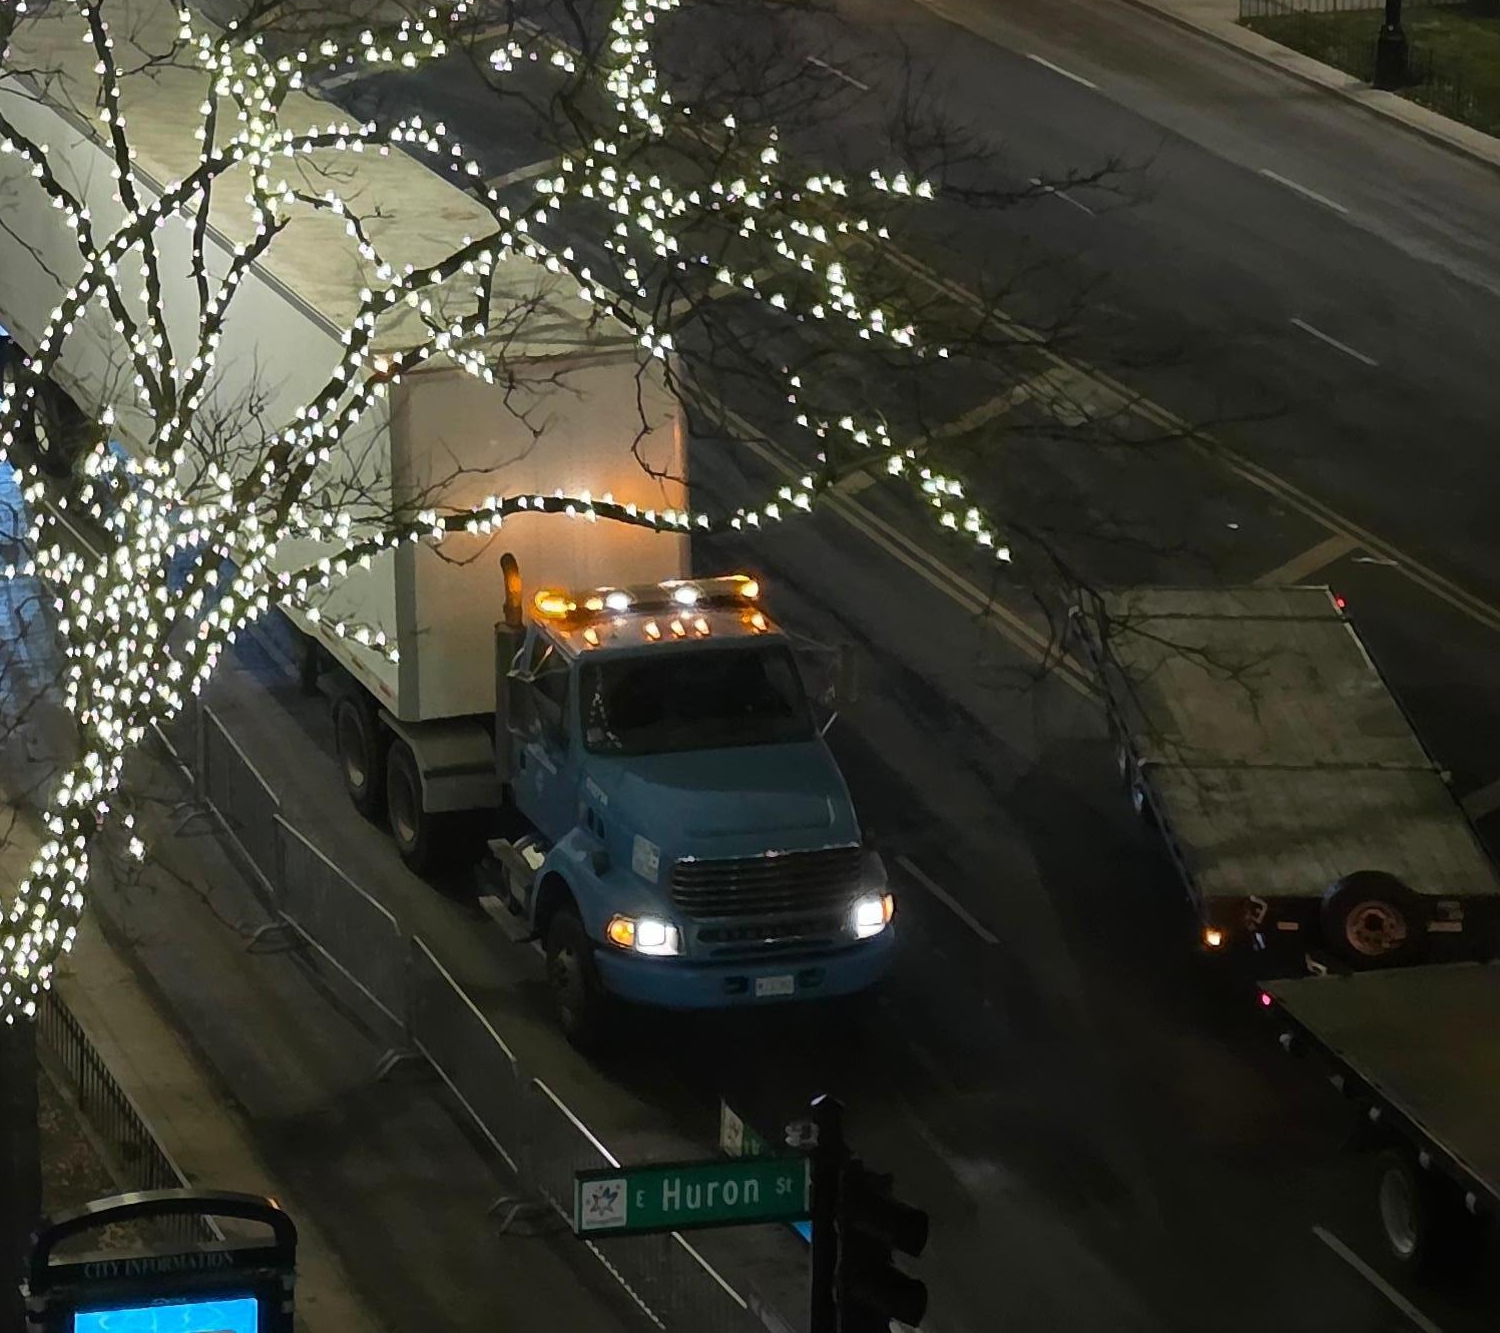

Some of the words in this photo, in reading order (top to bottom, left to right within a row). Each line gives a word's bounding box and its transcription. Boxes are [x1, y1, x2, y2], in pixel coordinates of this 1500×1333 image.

[635, 1189, 645, 1209] E
[662, 1175, 761, 1212] Huron
[775, 1175, 793, 1195] St
[83, 1260, 120, 1279] CITY
